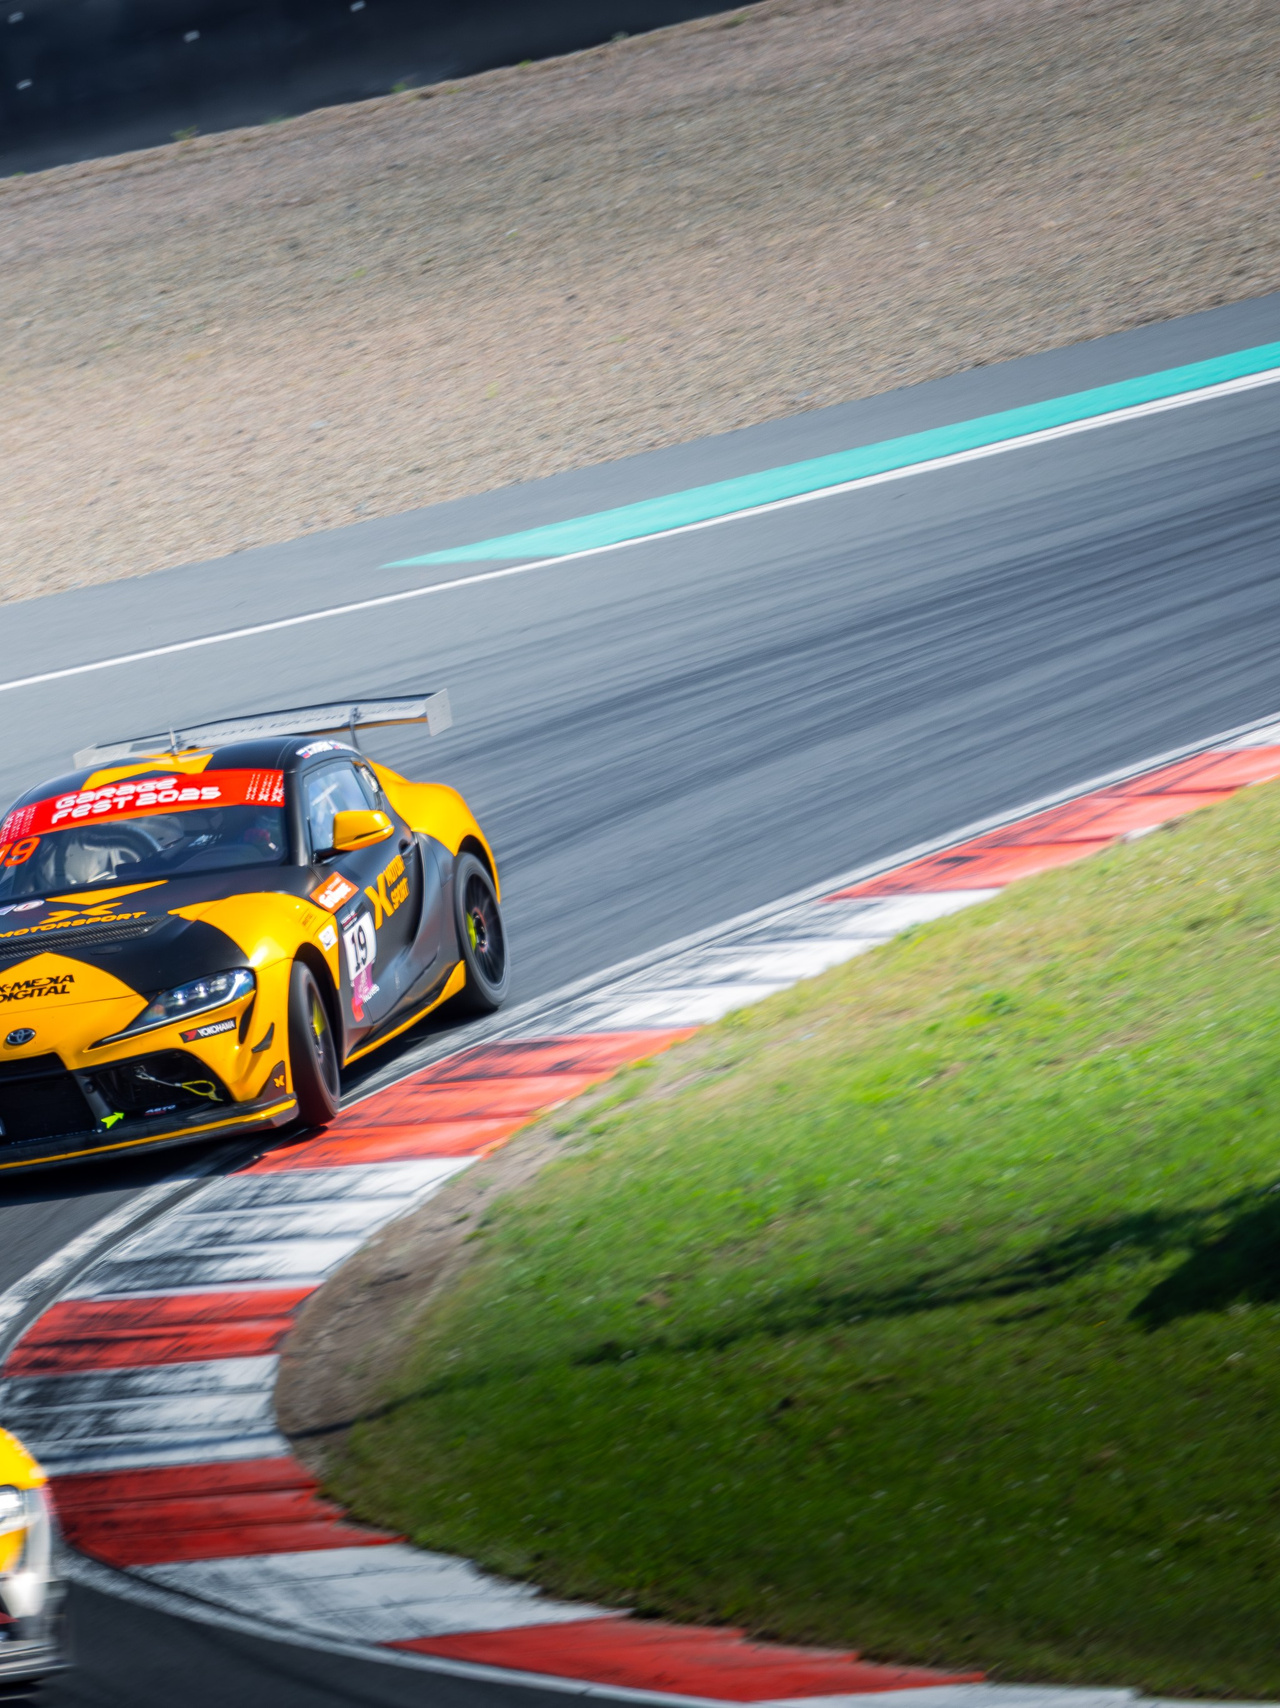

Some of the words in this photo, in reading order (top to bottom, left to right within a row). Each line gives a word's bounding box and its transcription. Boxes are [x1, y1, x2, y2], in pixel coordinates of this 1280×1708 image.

[135, 786, 222, 807] 2025
[351, 925, 368, 973] 19
[197, 1019, 235, 1037] YOKOHAMA
